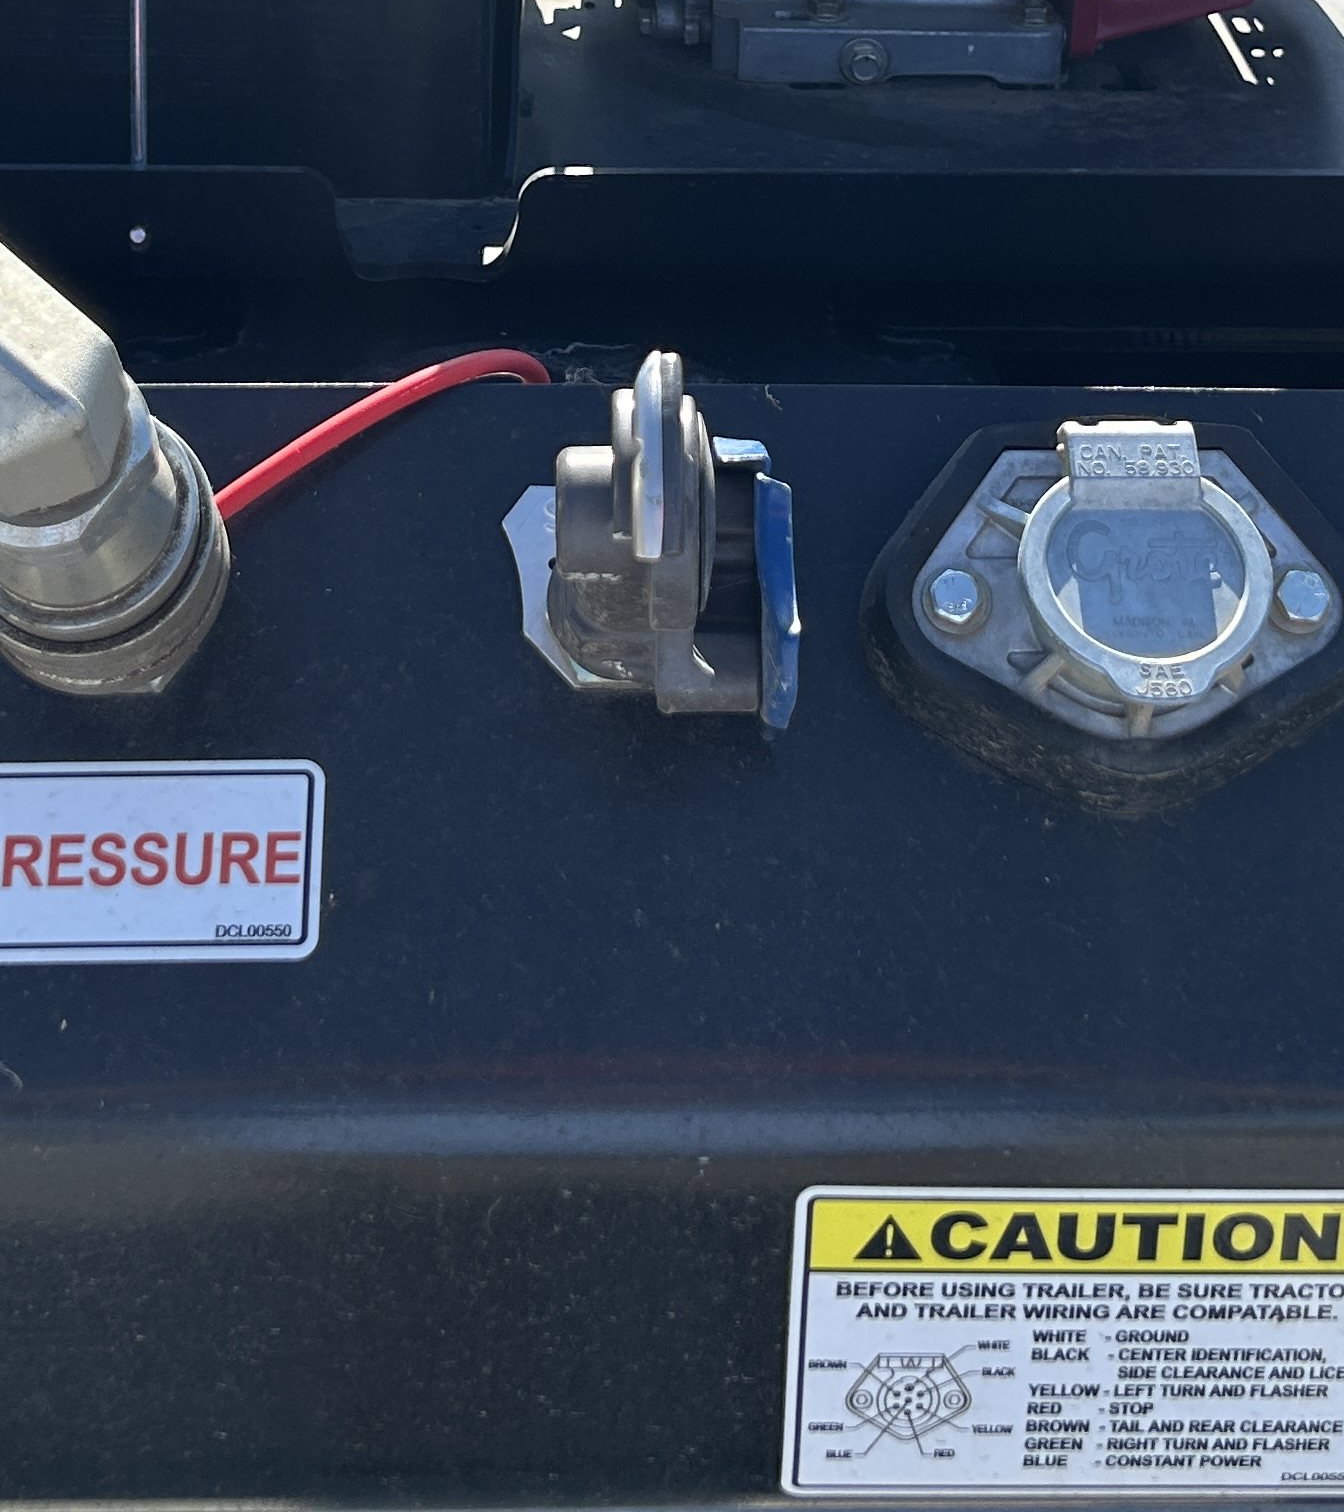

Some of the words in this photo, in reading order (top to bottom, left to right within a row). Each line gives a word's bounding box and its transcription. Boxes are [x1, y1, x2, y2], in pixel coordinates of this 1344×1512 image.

[1079, 443, 1127, 461] CAN.
[1138, 443, 1187, 461] PAT.
[1077, 461, 1110, 476] NO.
[1139, 664, 1185, 678] SAE
[1135, 681, 1193, 698] J560
[215, 924, 292, 937] DCL00550
[930, 1210, 1342, 1262] CAUTION
[836, 1282, 934, 1299] BEFORE
[941, 1282, 1016, 1299] USING
[1026, 1282, 1131, 1302] TRAILER,
[1138, 1282, 1170, 1299] BE
[1177, 1282, 1243, 1299] SURE
[856, 1303, 908, 1320] AND
[914, 1303, 1016, 1320] TRAILER
[1023, 1303, 1110, 1320] WIRING
[1116, 1303, 1166, 1320] ARE
[1172, 1303, 1339, 1321] COMPATABLE.
[1032, 1330, 1086, 1342] WHITE
[1115, 1330, 1189, 1342] GROUND
[1031, 1348, 1090, 1360] BLACK
[1118, 1348, 1187, 1360] CENTER
[1191, 1348, 1327, 1363] IDENTIFICATION,
[808, 1359, 847, 1369] BROWN
[981, 1367, 1015, 1376] BLACK
[1118, 1366, 1156, 1379] SIDE
[1161, 1366, 1265, 1379] CLEARANCE
[1268, 1366, 1305, 1379] AND
[1028, 1384, 1101, 1396] YELLOW
[1113, 1384, 1156, 1396] LEFT
[1160, 1384, 1205, 1396] TURN
[1209, 1384, 1246, 1396] AND
[1250, 1384, 1329, 1396] FLASHER
[1027, 1402, 1062, 1414] RED
[1109, 1402, 1154, 1414] STOP
[808, 1422, 843, 1431] GREEN
[971, 1424, 1013, 1434] YELLOW
[1025, 1420, 1090, 1432] BROWN
[1109, 1420, 1144, 1432] TAIL
[1148, 1420, 1184, 1432] AND
[1188, 1420, 1235, 1432] REAR
[1240, 1420, 1344, 1432] CLEARANCE
[1024, 1437, 1083, 1450] GREEN
[1107, 1437, 1157, 1450] RIGHT
[1162, 1437, 1208, 1450] TURN
[1212, 1437, 1248, 1450] AND
[1252, 1437, 1330, 1450] FLASHER
[826, 1450, 853, 1458] BLUE
[933, 1449, 955, 1458] RED
[1023, 1455, 1068, 1467] BLUE
[1105, 1455, 1195, 1467] CONSTANT
[1199, 1455, 1262, 1467] POWER
